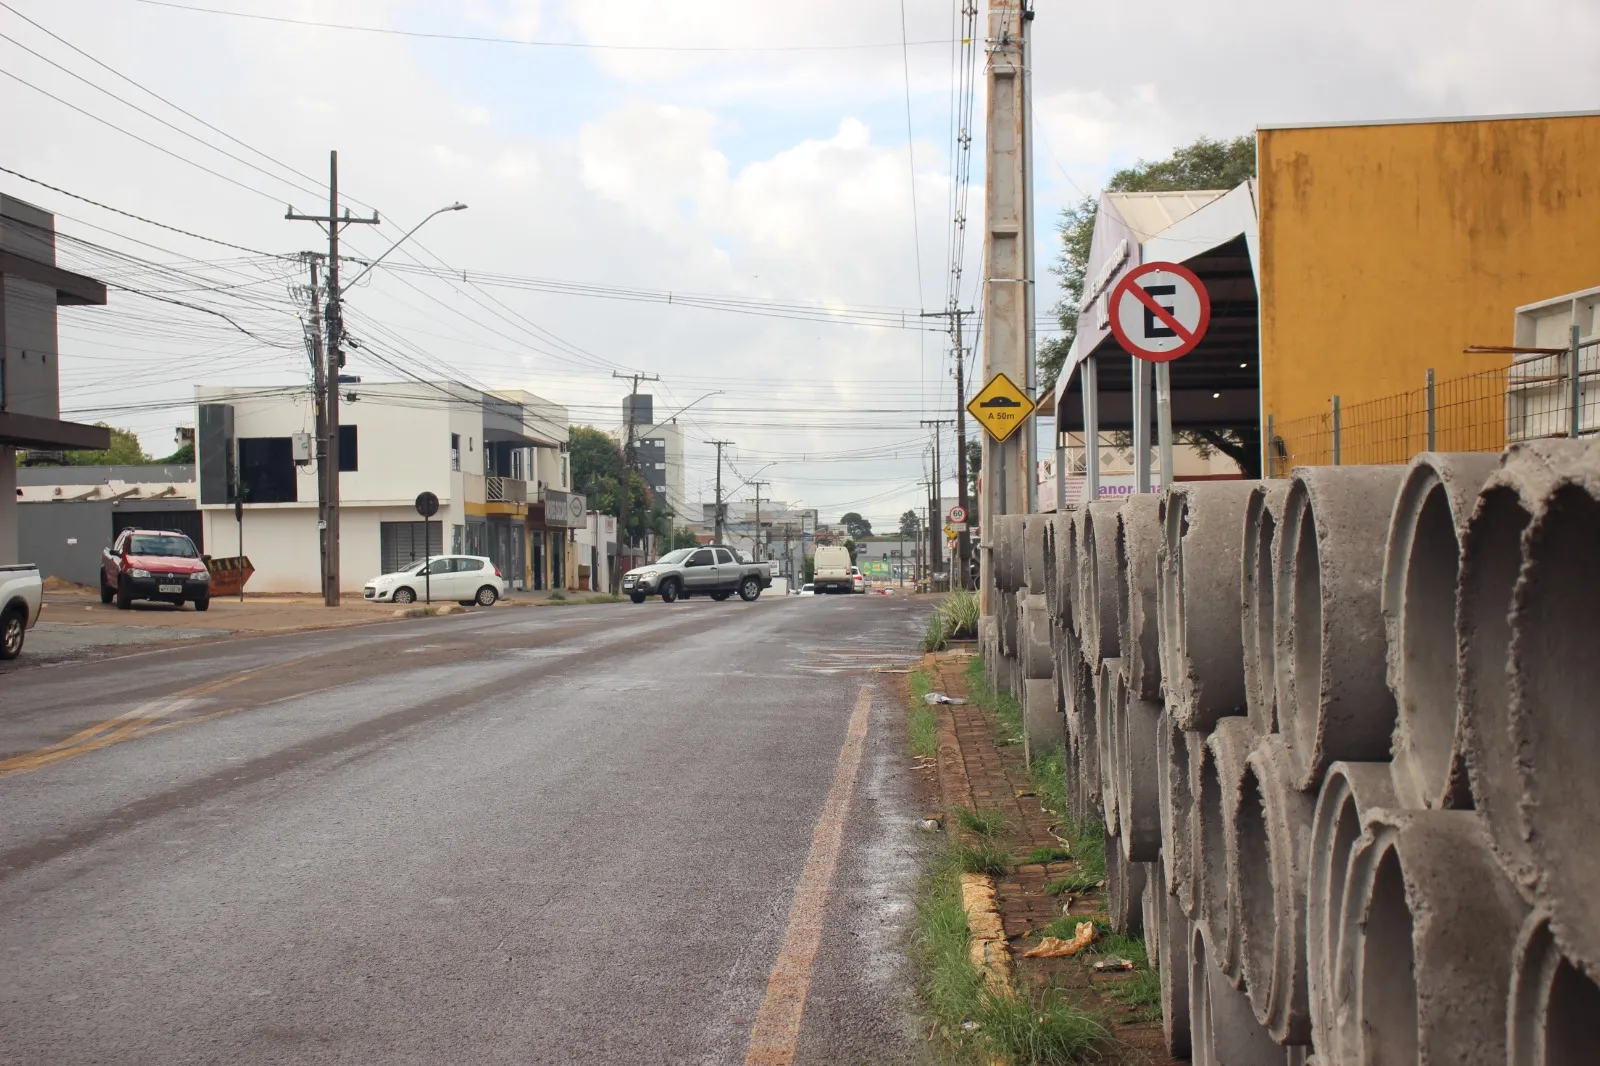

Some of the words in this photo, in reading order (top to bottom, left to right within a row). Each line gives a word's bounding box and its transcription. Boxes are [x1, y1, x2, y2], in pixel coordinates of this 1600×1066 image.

[1143, 285, 1177, 338] E
[988, 412, 995, 420] A
[997, 412, 1015, 420] 50m
